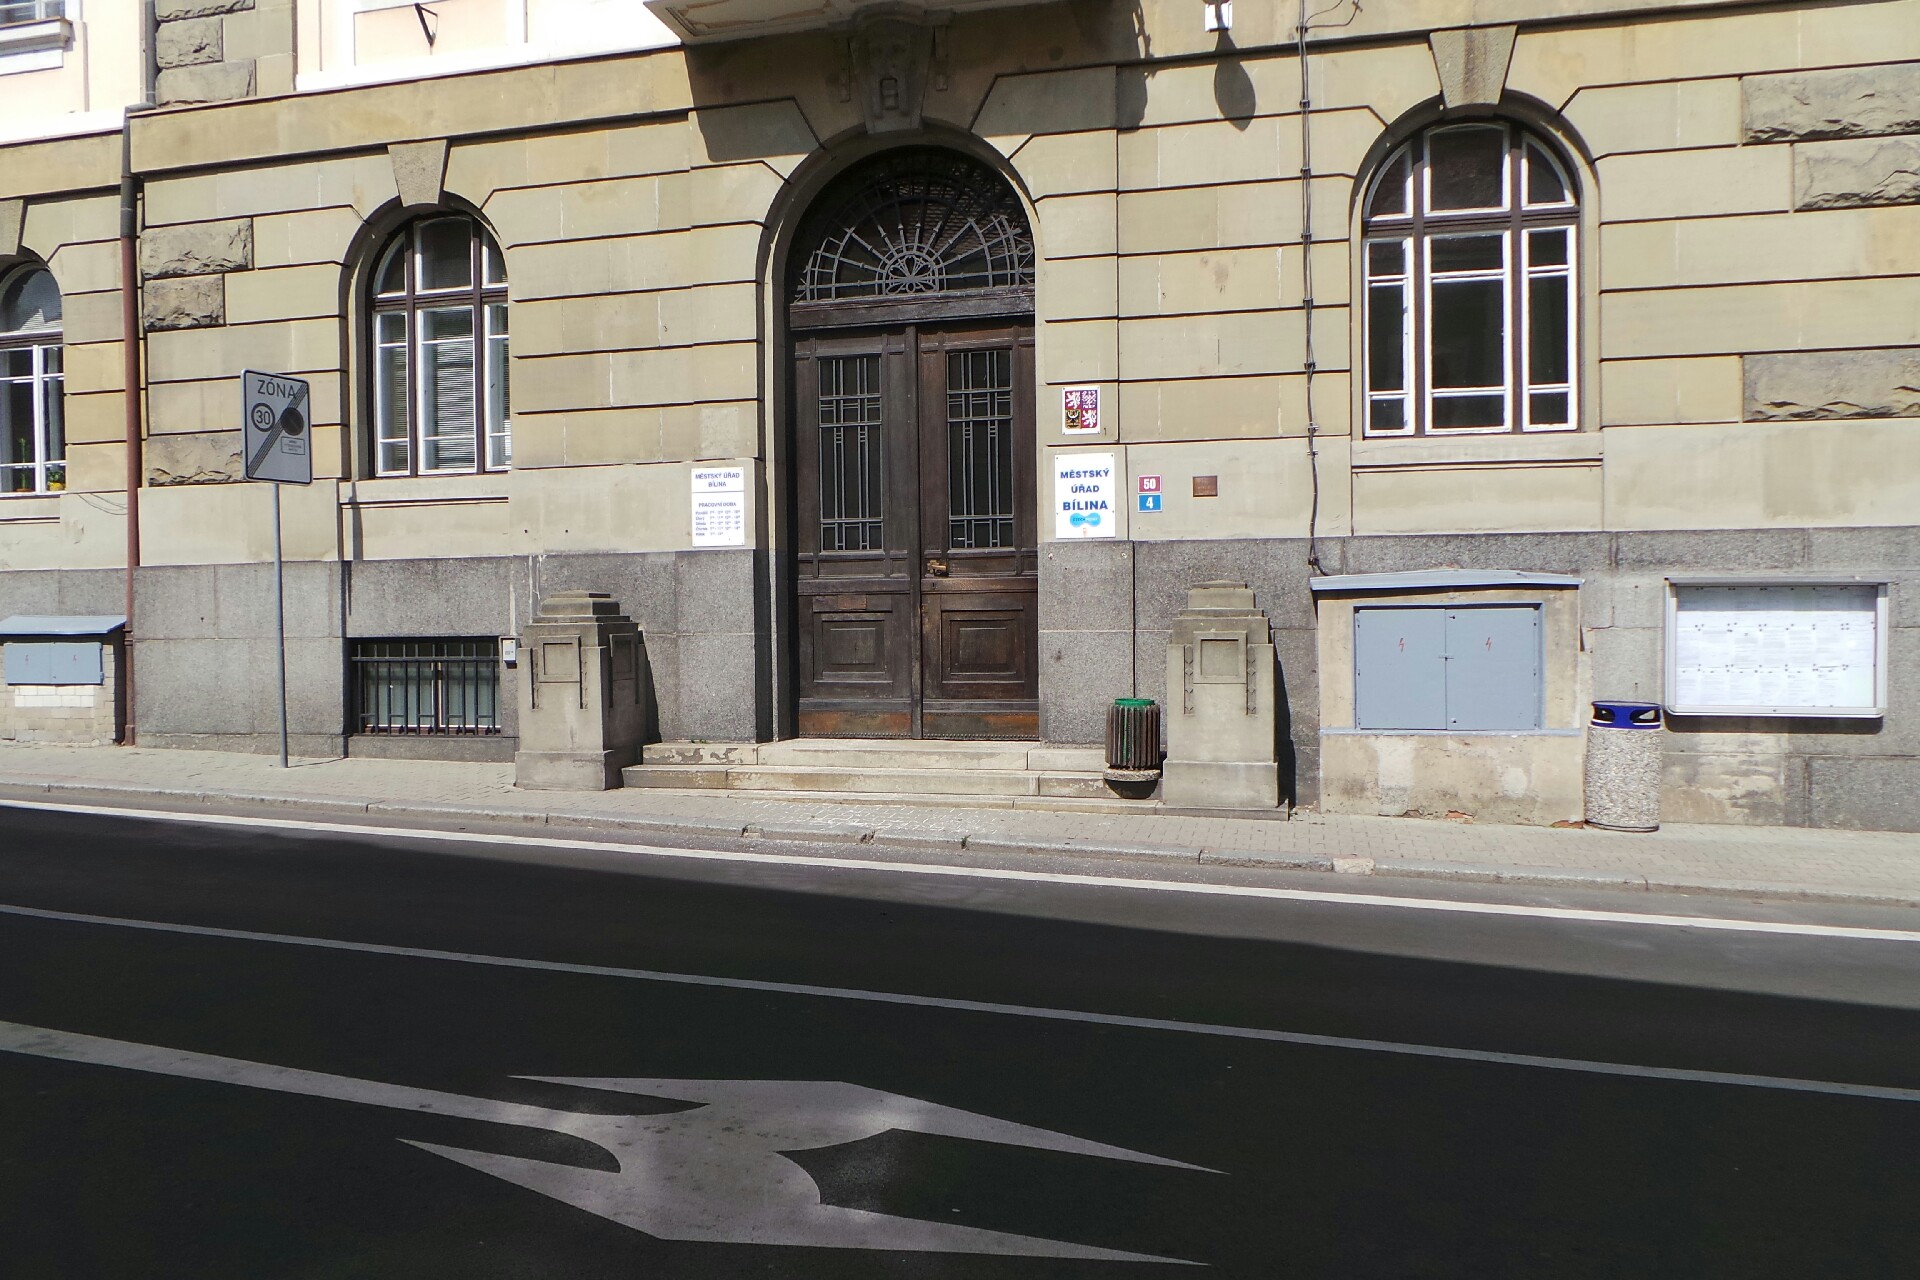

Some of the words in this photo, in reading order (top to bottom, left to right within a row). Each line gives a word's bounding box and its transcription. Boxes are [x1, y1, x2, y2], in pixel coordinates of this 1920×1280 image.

[257, 378, 297, 400] ZÓNA
[255, 410, 271, 425] 30
[695, 472, 722, 480] MĚSTSKÝ
[1060, 468, 1110, 479] MĚSTSKÝ
[1071, 484, 1100, 494] ÚŘAD
[1143, 478, 1157, 490] 50
[1062, 499, 1109, 511] BÍLINA
[1145, 496, 1154, 509] 4
